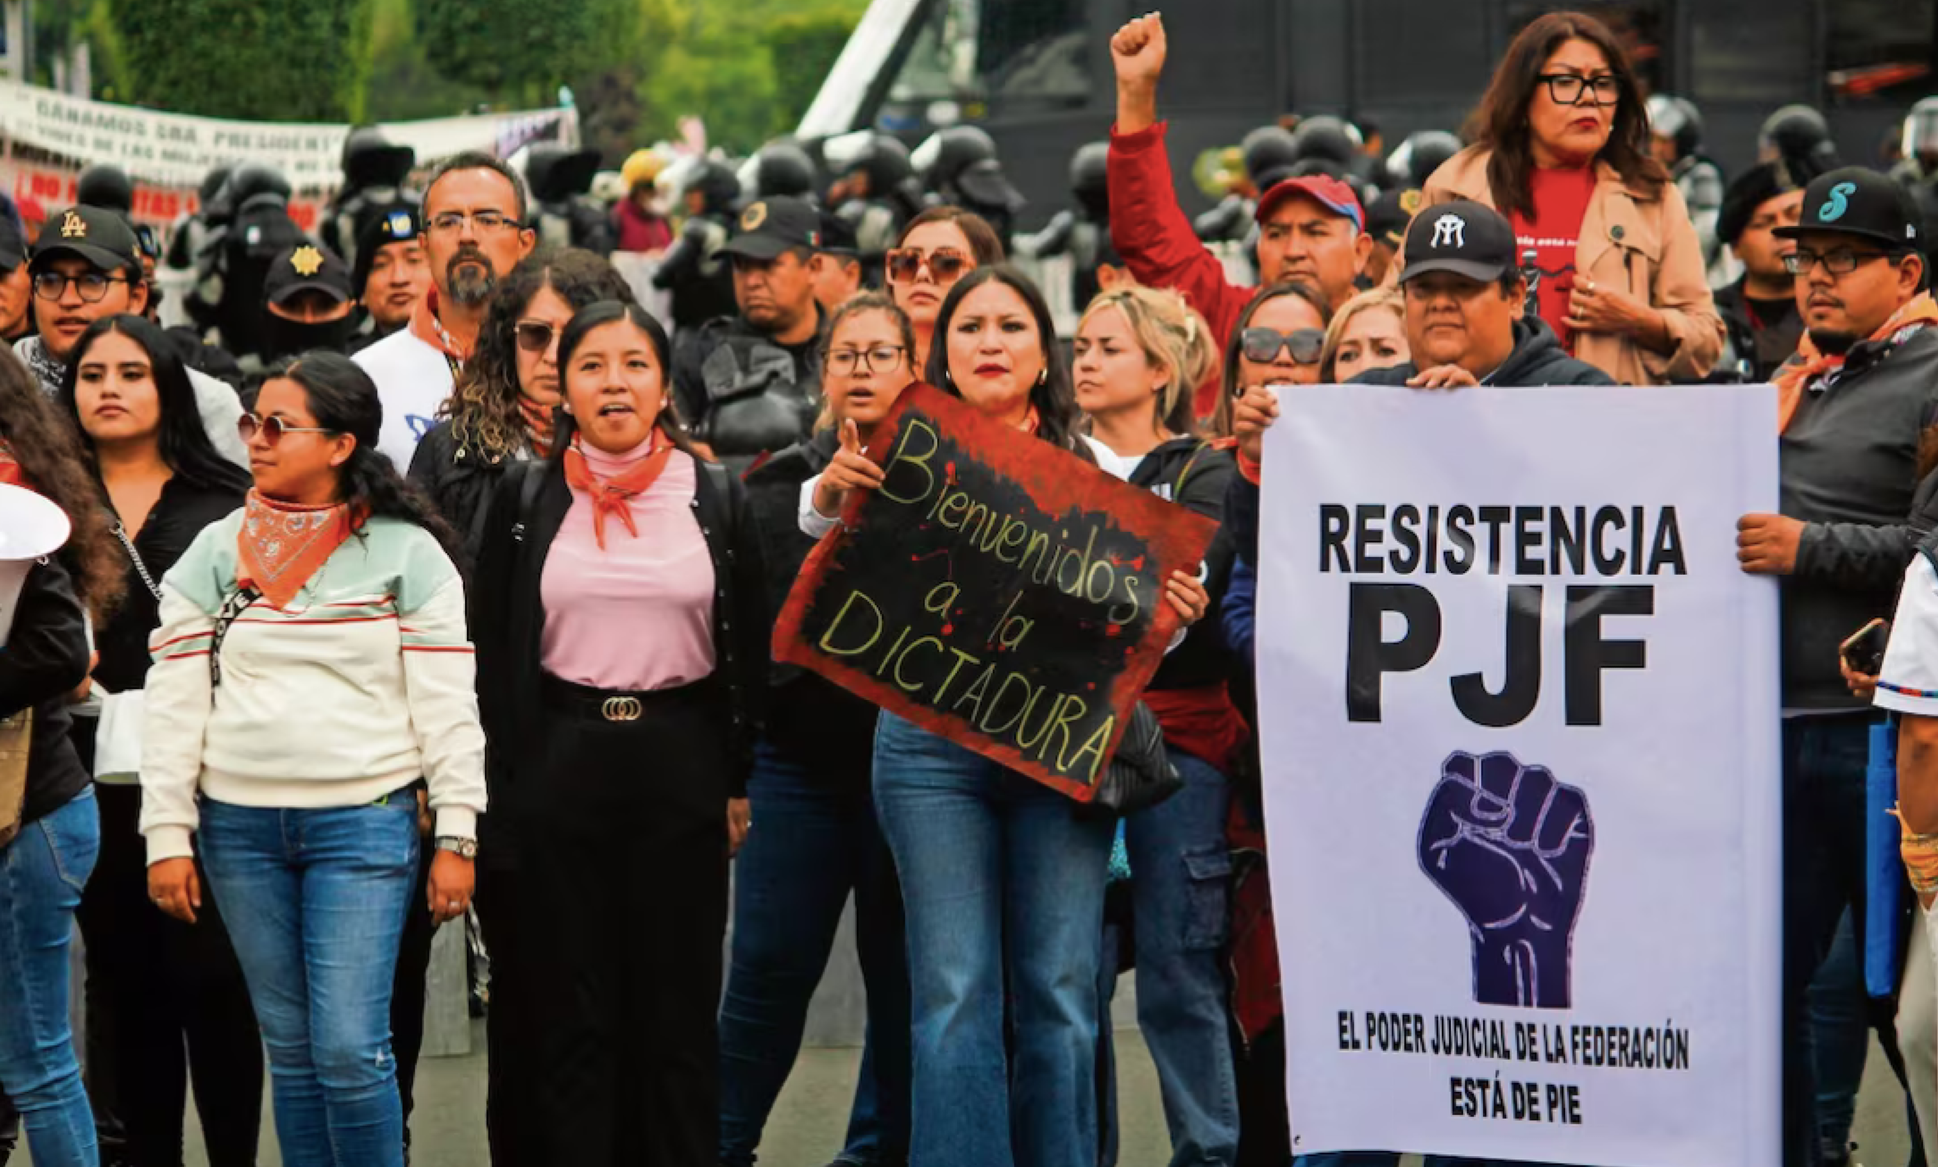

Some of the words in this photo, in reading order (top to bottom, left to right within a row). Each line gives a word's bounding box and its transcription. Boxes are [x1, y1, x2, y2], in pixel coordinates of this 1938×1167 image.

[61, 211, 86, 237] LA
[879, 418, 1139, 625] Bienvenidos
[1319, 503, 1688, 577] RESISTENCIA
[924, 581, 960, 619] a
[987, 590, 1035, 652] la
[819, 590, 1116, 784] DICTADURA
[1345, 581, 1655, 728] PJF
[1337, 1010, 1361, 1050] EL
[1365, 1011, 1427, 1054] PODER
[1430, 1014, 1511, 1061] JUDICIAL
[1514, 1021, 1539, 1062] DE
[1543, 1023, 1568, 1064] LA
[1570, 1018, 1689, 1070] FEDERACIÓN
[1450, 1069, 1508, 1120] ESTÁ
[1510, 1080, 1541, 1122] DE
[1545, 1083, 1583, 1125] PIE
